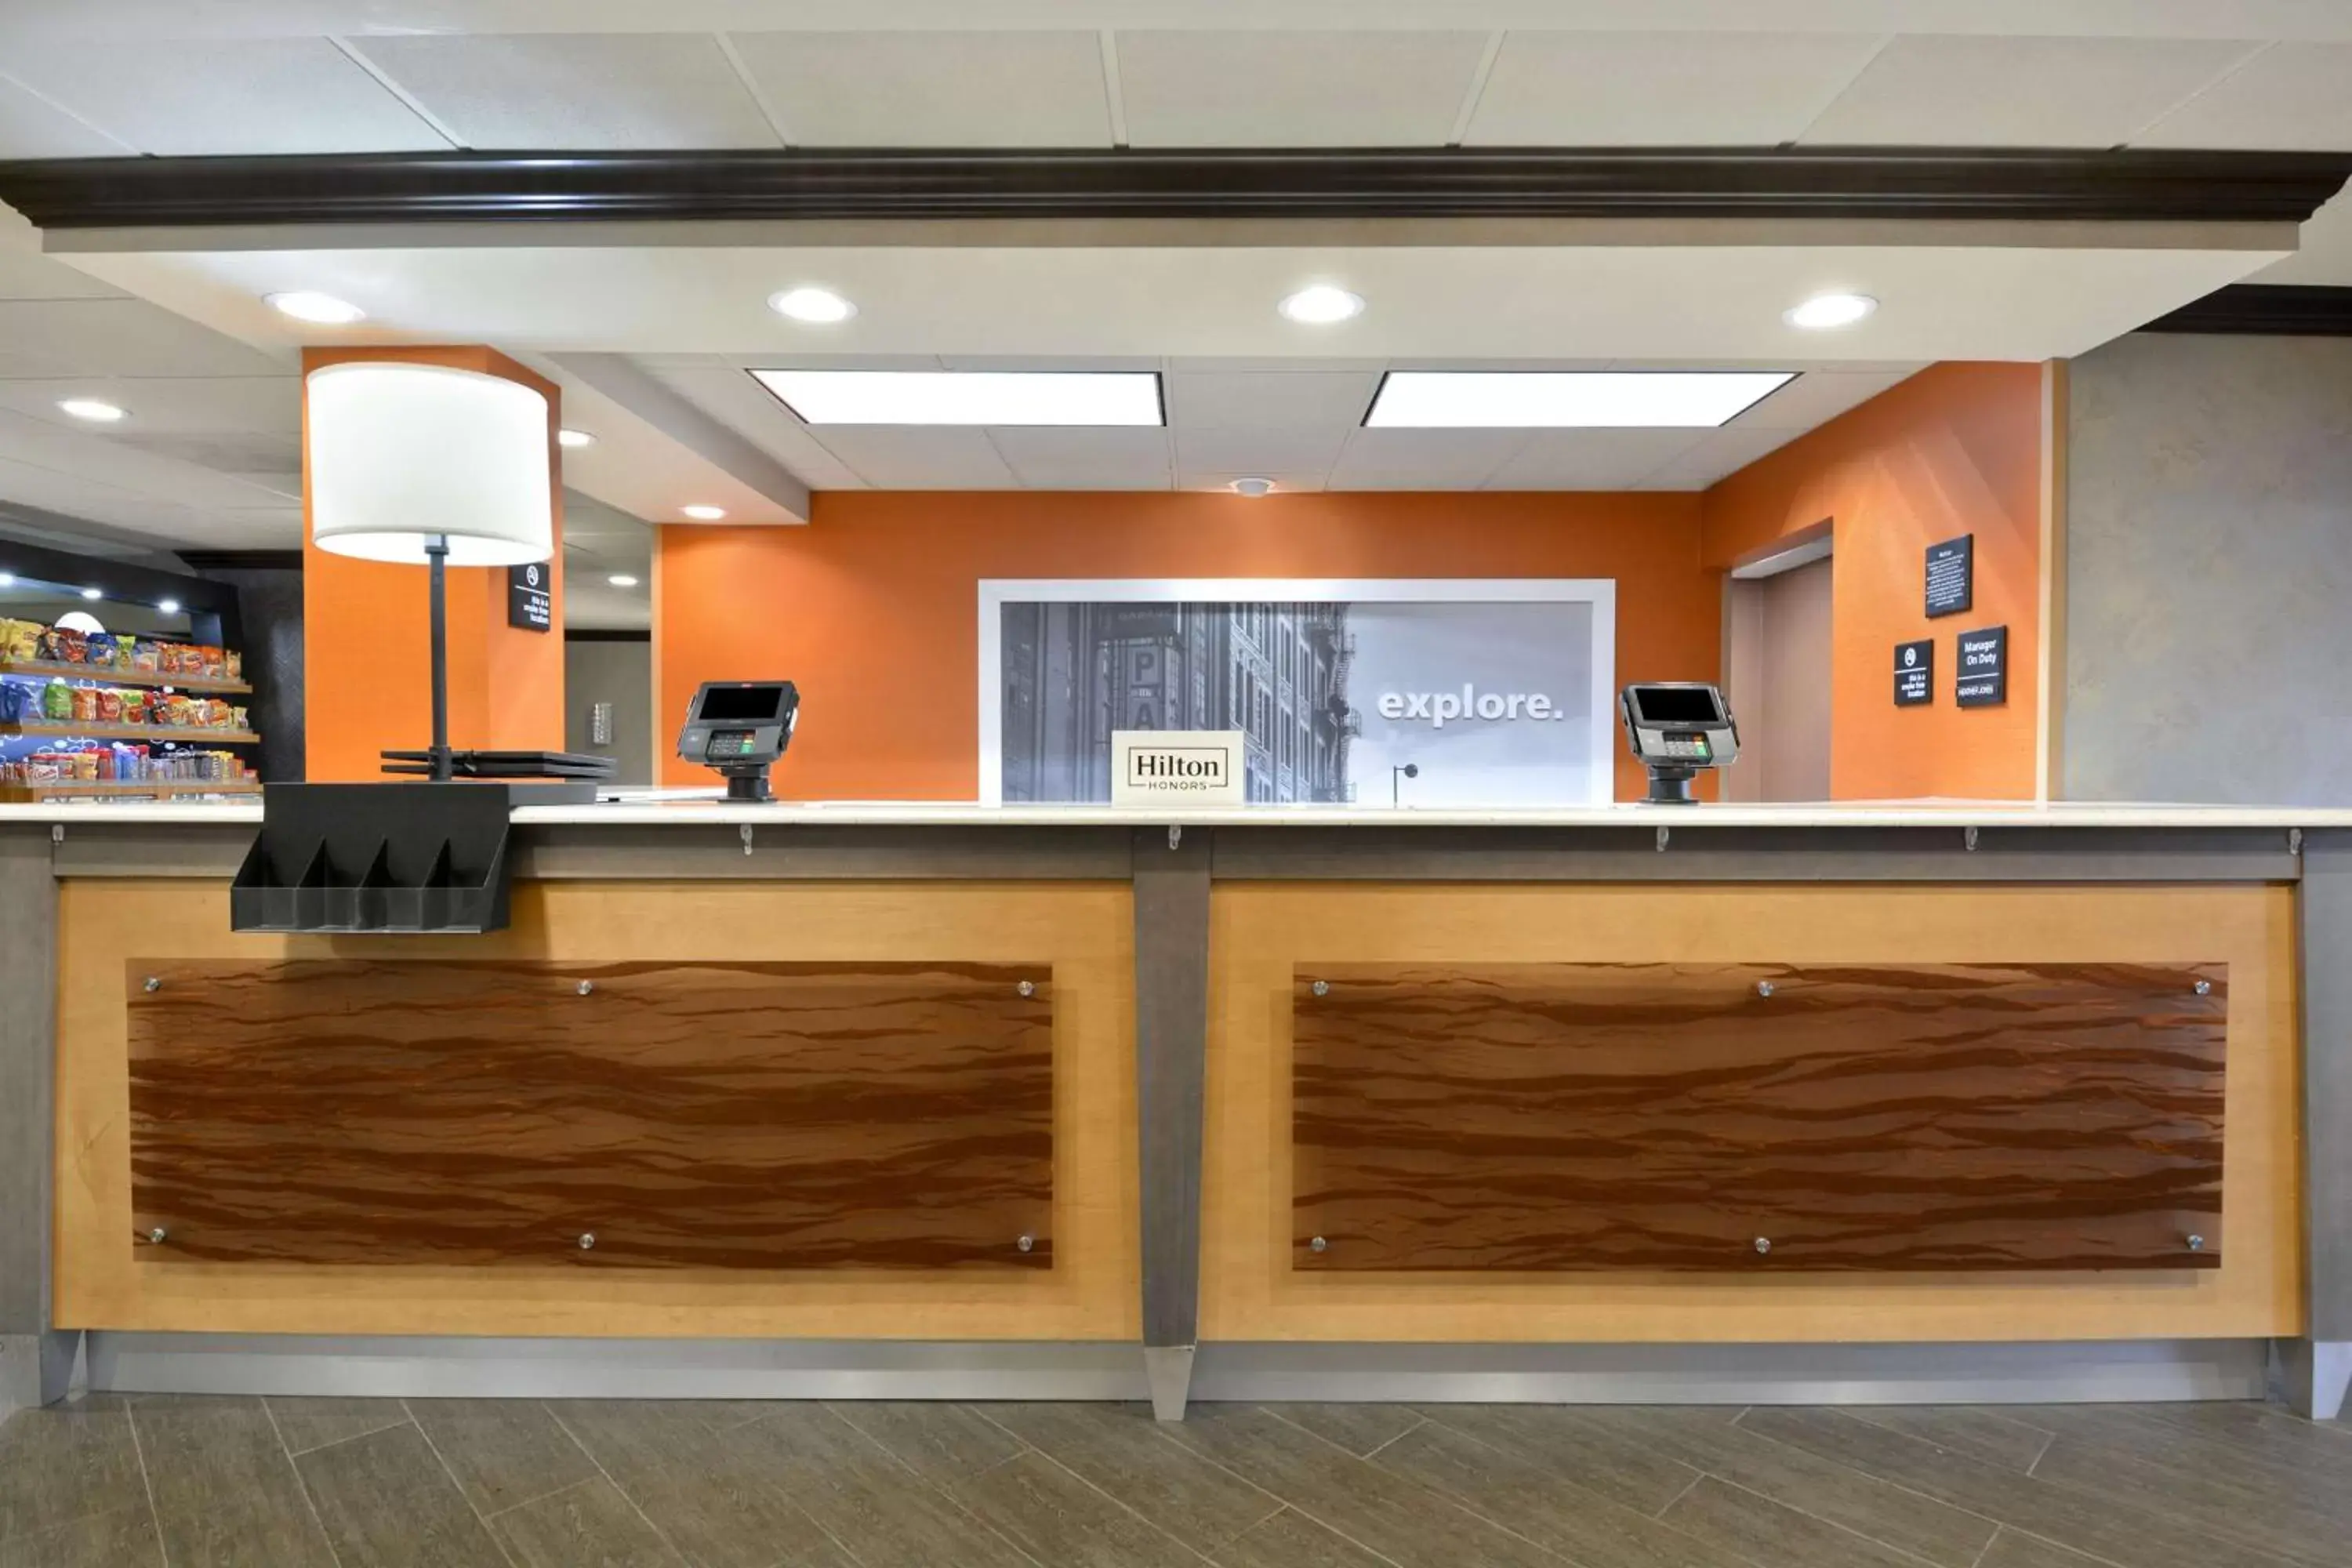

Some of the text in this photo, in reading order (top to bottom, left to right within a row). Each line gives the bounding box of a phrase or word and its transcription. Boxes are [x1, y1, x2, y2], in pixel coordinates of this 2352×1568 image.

[1964, 640, 1996, 652] Manager
[1966, 653, 1997, 666] On Duty
[1377, 683, 1563, 729] explore.
[1138, 755, 1218, 776] Hilton
[1149, 781, 1207, 790] HONORS
